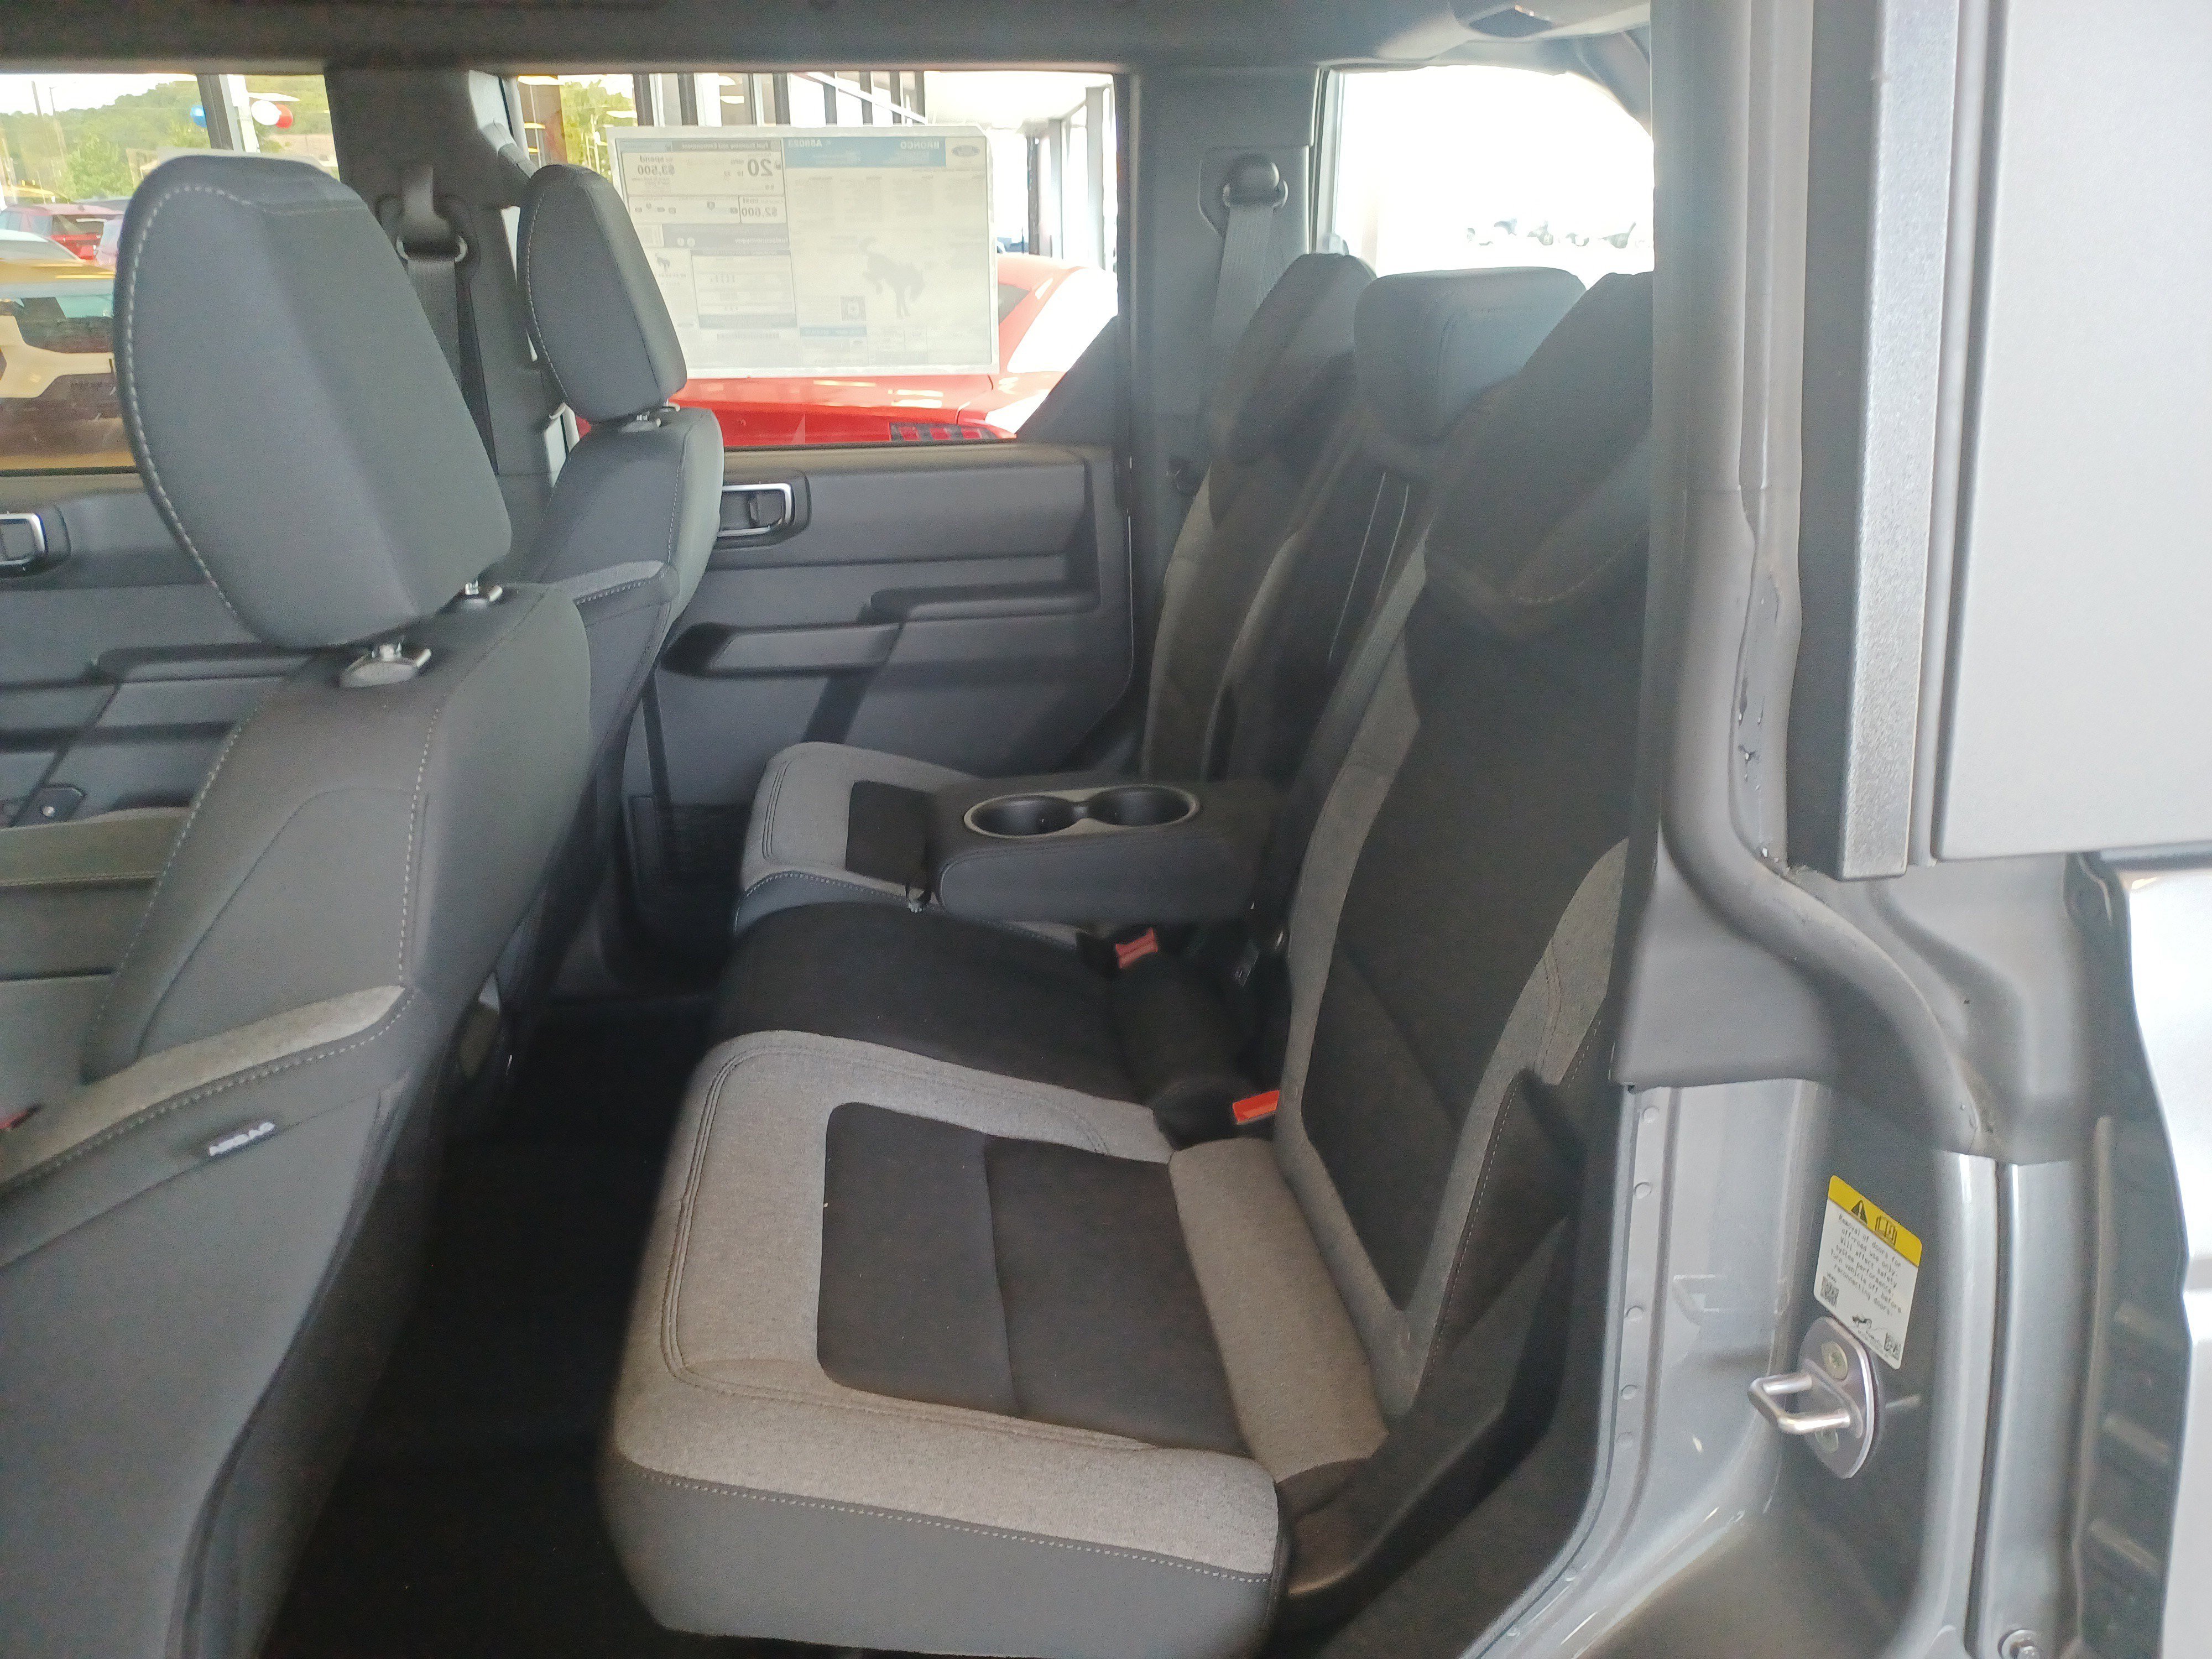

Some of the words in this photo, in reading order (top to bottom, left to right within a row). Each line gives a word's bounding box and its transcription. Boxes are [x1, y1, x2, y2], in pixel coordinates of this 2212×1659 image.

[1839, 1214, 1860, 1237] Removal
[1836, 1244, 1854, 1262] system
[1845, 1263, 1867, 1285] vehicle
[1881, 1291, 1902, 1313] before
[1877, 1268, 1897, 1288] safety
